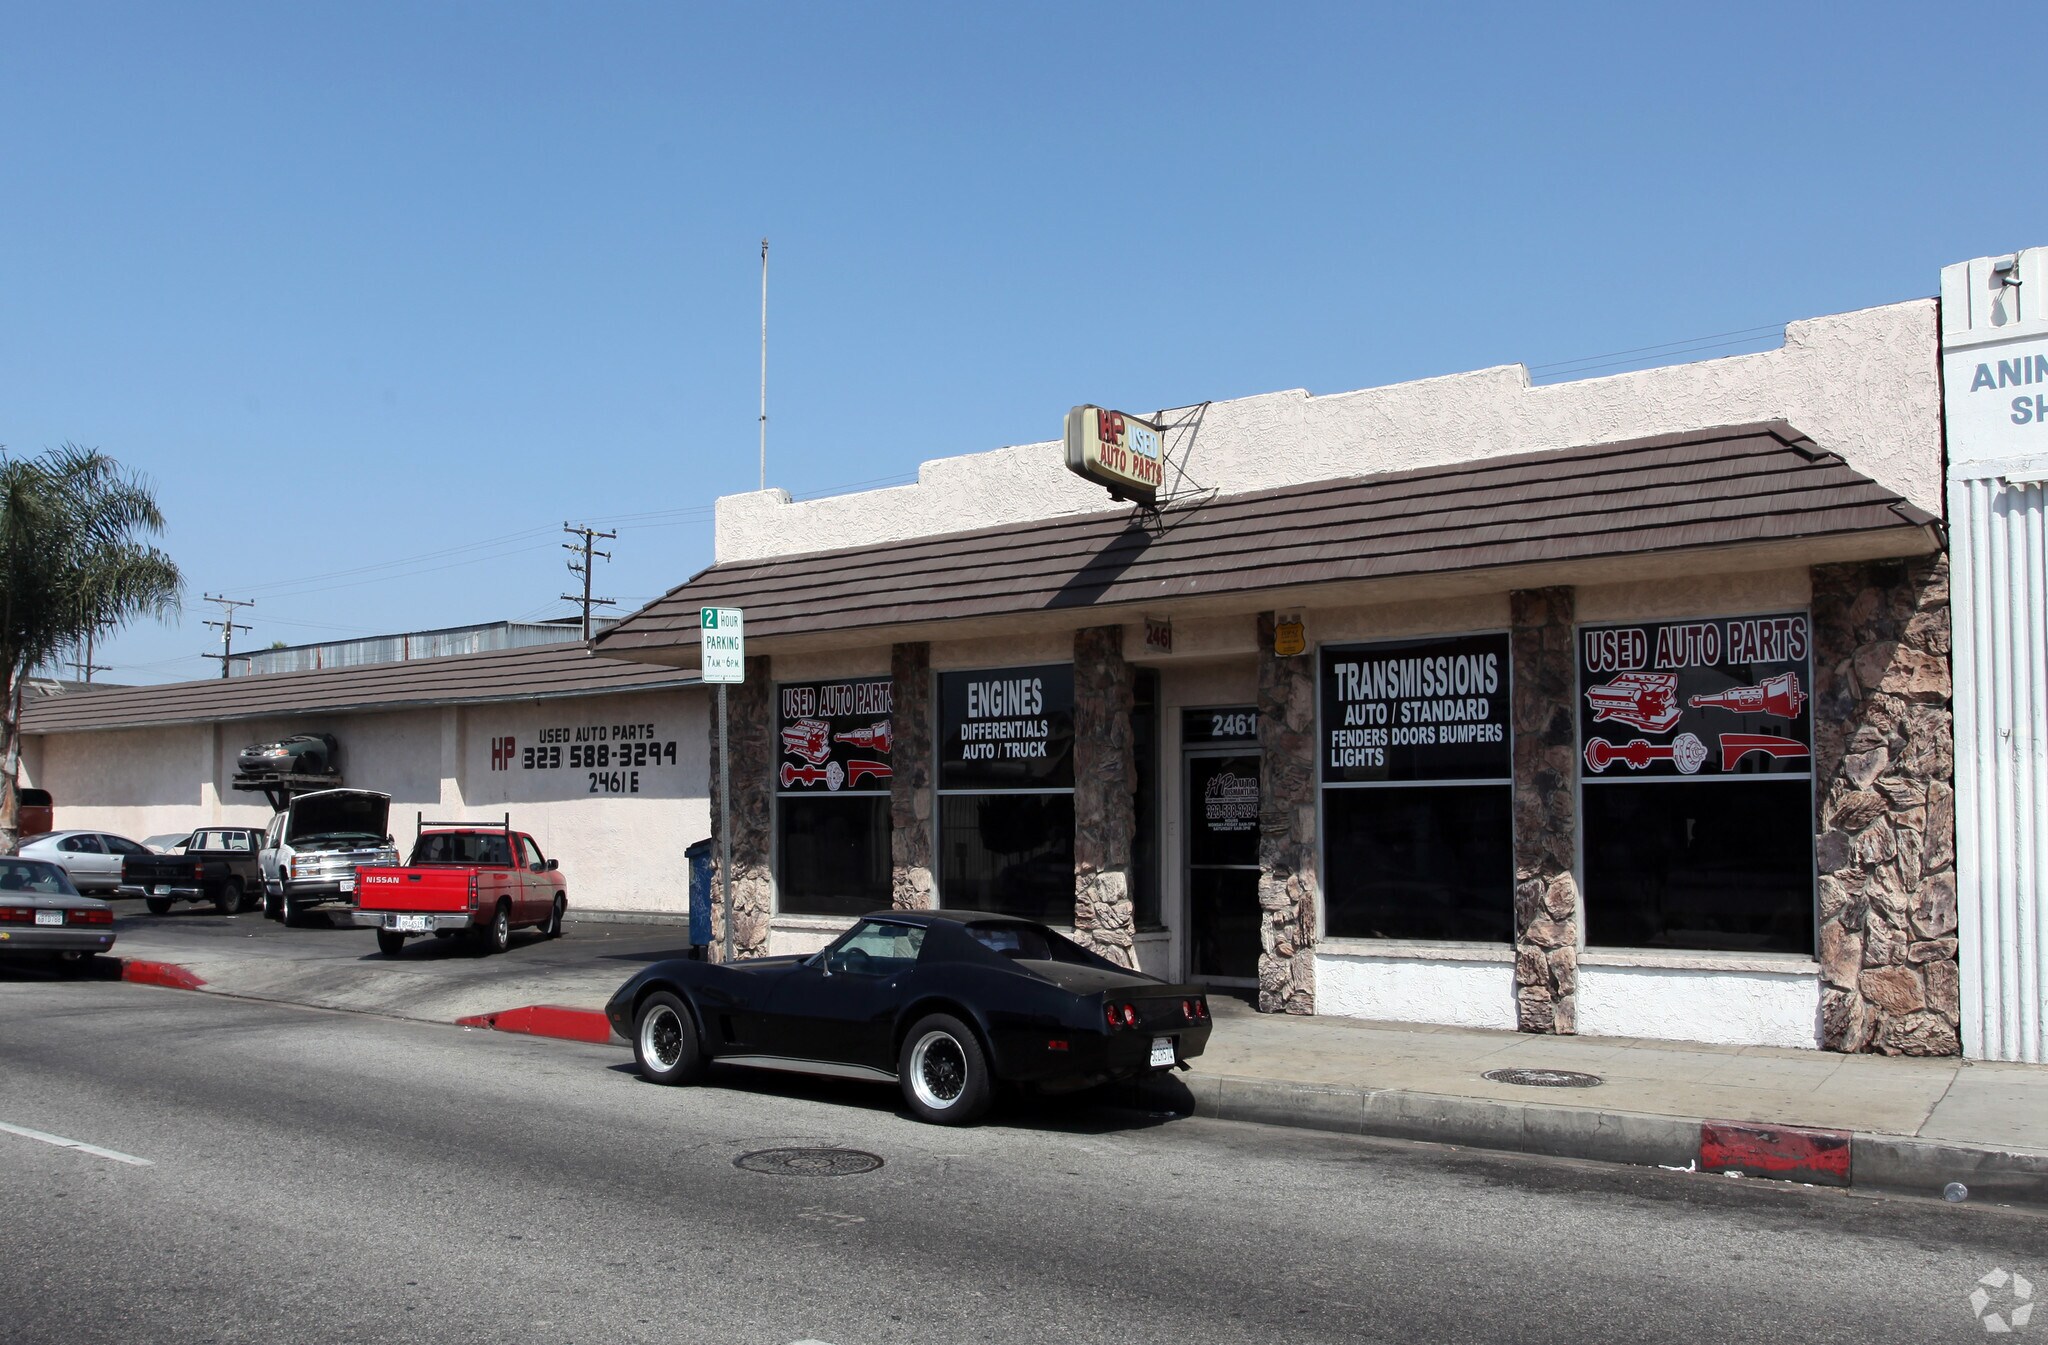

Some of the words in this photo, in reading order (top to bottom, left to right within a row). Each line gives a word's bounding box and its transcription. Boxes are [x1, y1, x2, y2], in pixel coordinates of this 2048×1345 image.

[1127, 424, 1158, 460] USED
[1100, 442, 1127, 473] AUTO
[1132, 454, 1162, 485] PARTS
[705, 609, 714, 627] 2
[720, 615, 739, 628] HOUR
[706, 635, 740, 650] PARKING
[1146, 623, 1172, 650] 2461
[1585, 629, 1649, 672] USED
[1654, 622, 1722, 669] AUTO
[1727, 617, 1808, 665] PARTS
[1334, 652, 1499, 702] TRANSMISSIONS
[782, 687, 816, 719] USED
[818, 684, 854, 717] AUTO
[968, 677, 1043, 719] ENGINES
[1344, 702, 1388, 726] AUTO
[1391, 702, 1397, 725] /
[1400, 698, 1490, 724] STANDARD
[539, 728, 570, 743] USED
[575, 726, 607, 742] AUTO
[612, 724, 654, 740] PARTS
[961, 719, 1049, 741] DIFFERENTIALS
[1211, 713, 1257, 737] 2461
[1331, 728, 1389, 748] FENDERS
[1391, 725, 1437, 746] DOORS
[1439, 723, 1504, 744] BUMPERS
[491, 736, 516, 771] HP
[521, 745, 564, 770] (323)
[569, 741, 678, 769] 588-3294
[962, 743, 995, 760] AUTO
[997, 742, 1002, 759] /
[1004, 740, 1047, 758] TRUCK
[1331, 747, 1385, 768] LIGHTS
[588, 771, 626, 793] 2461
[1232, 777, 1258, 789] AUTO
[366, 876, 400, 884] NISSAN
